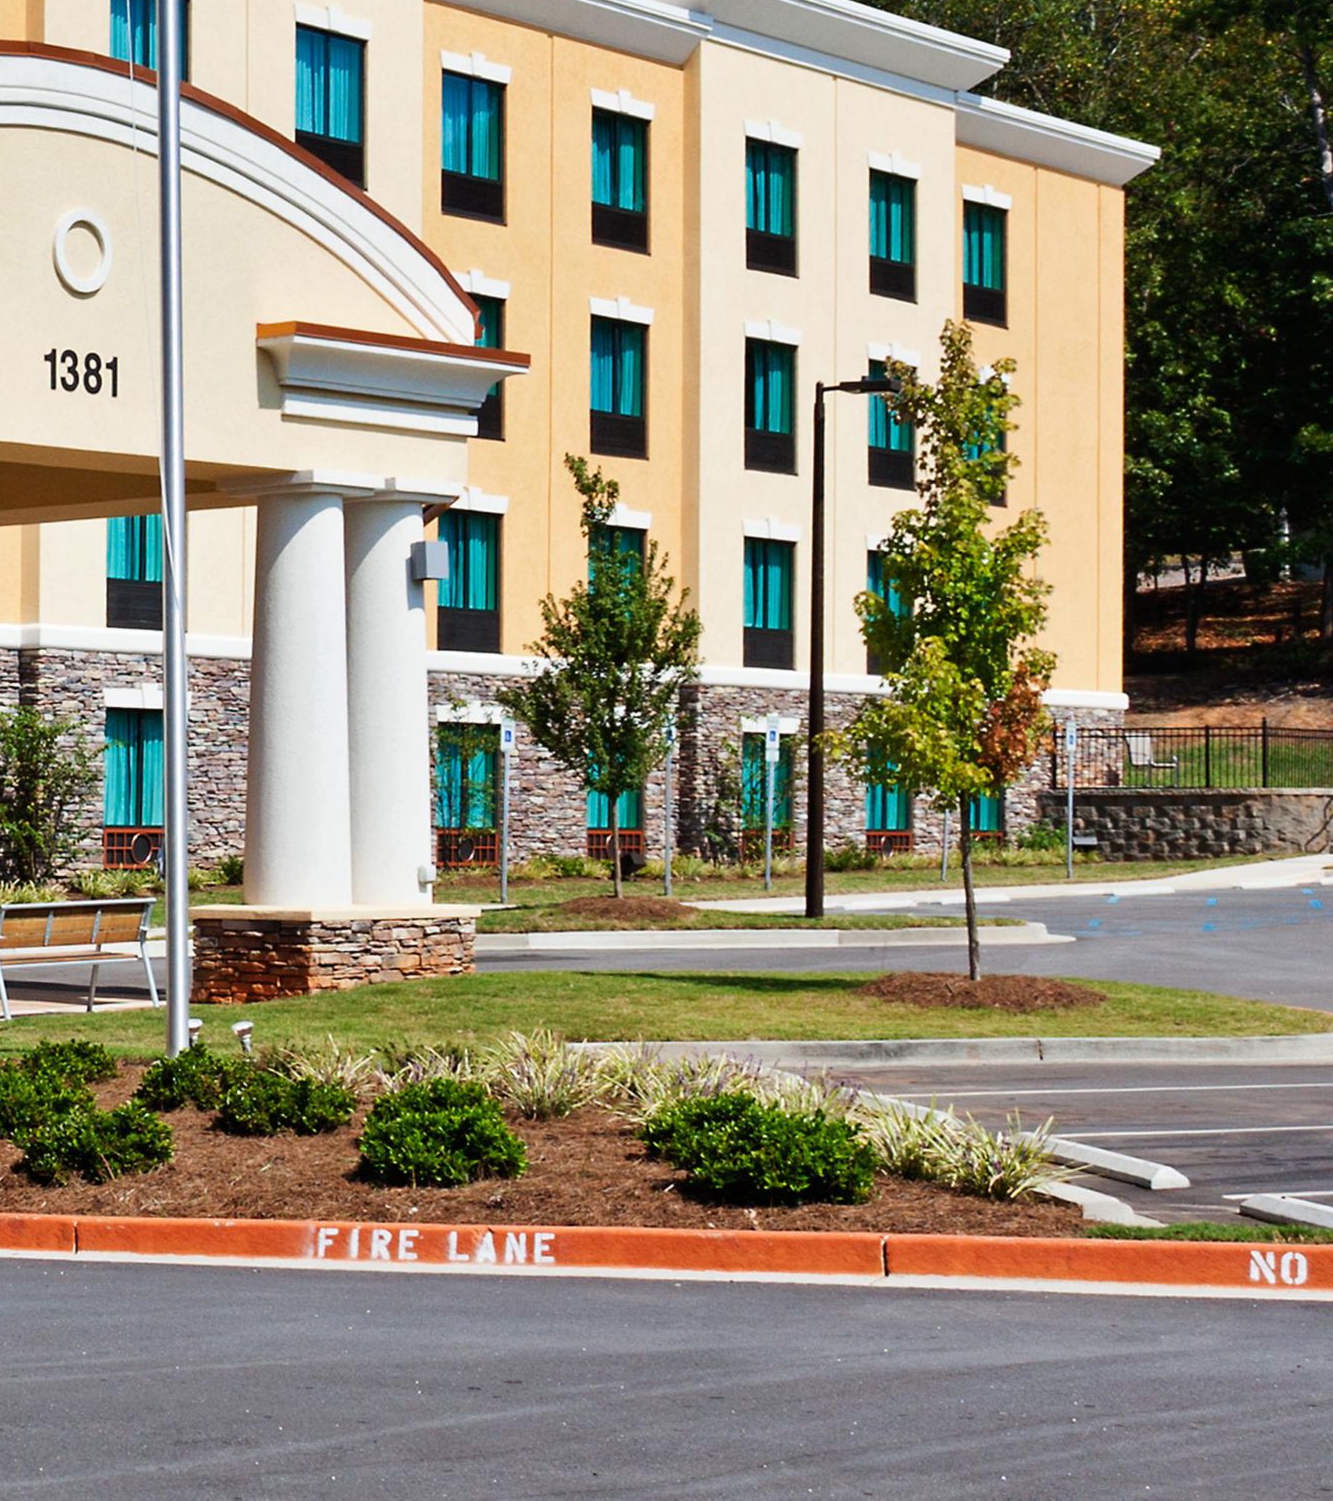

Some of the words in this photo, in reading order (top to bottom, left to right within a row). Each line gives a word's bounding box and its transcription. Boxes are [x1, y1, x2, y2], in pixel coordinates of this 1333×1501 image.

[44, 348, 118, 398] 1381
[317, 1227, 420, 1260] FIRE
[448, 1230, 556, 1264] LANE
[1249, 1250, 1308, 1285] NO
